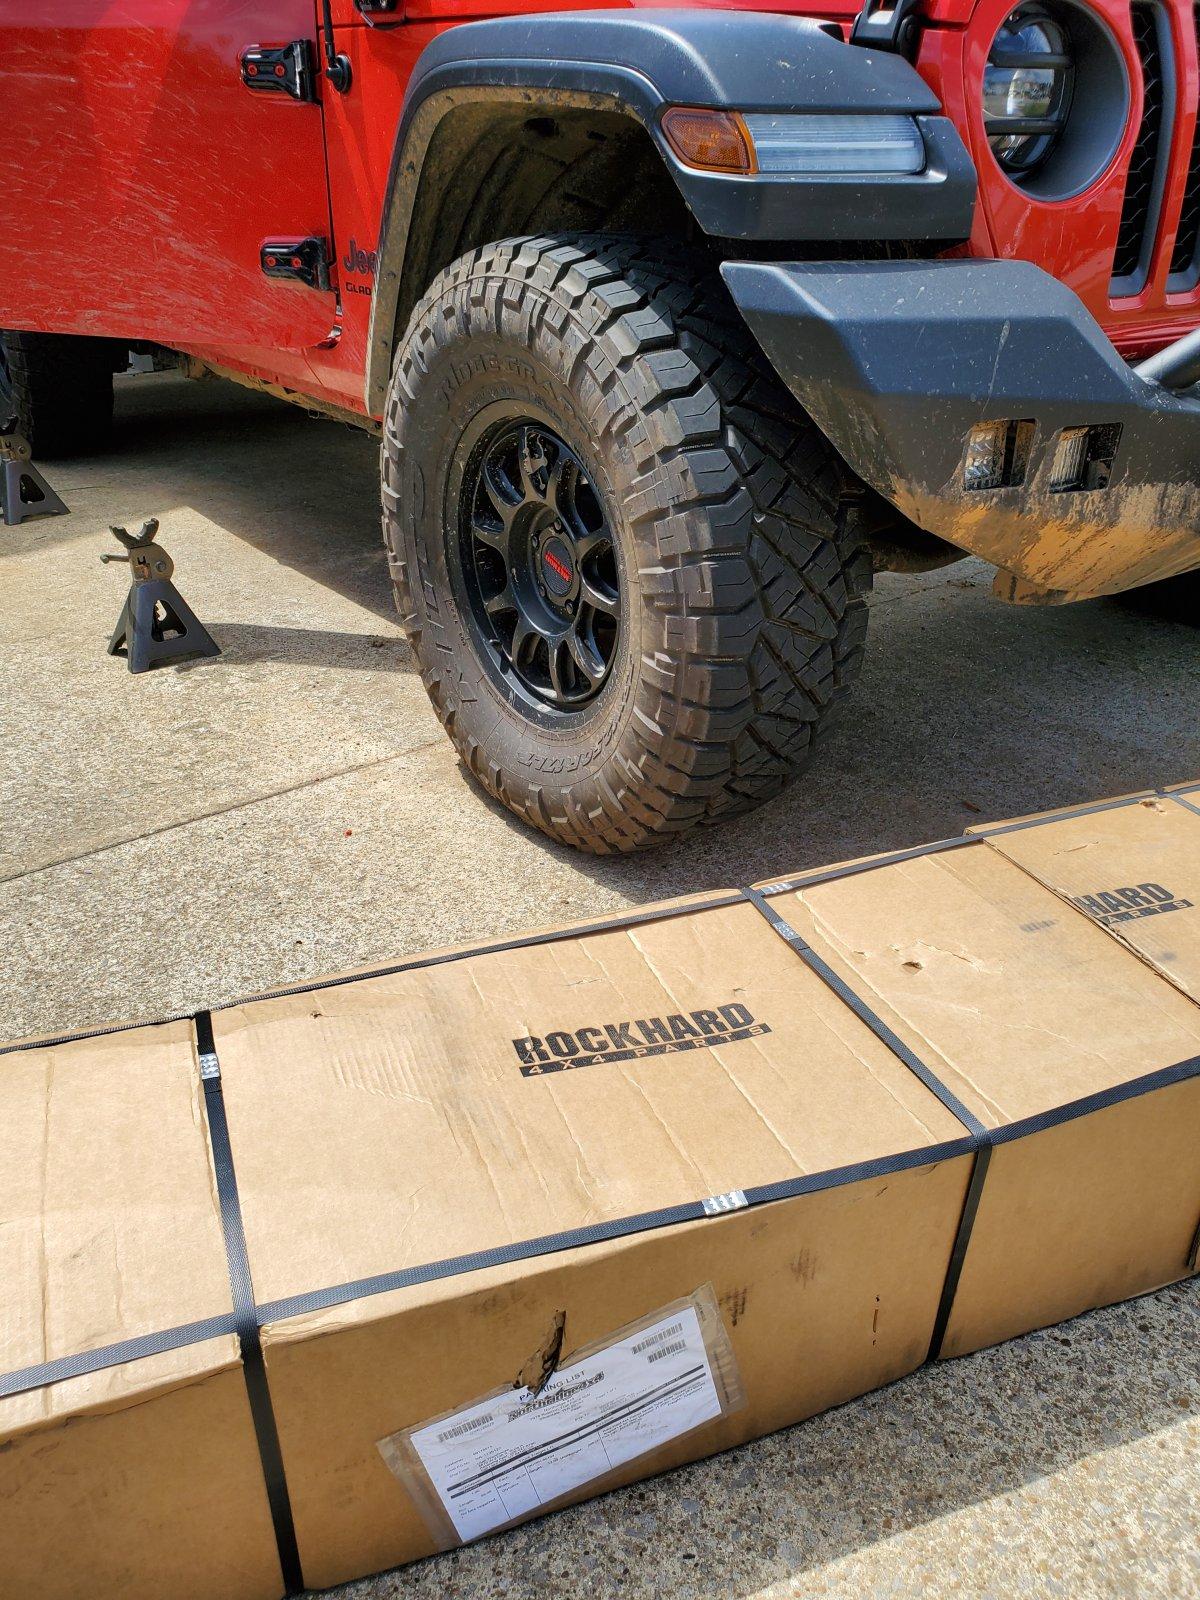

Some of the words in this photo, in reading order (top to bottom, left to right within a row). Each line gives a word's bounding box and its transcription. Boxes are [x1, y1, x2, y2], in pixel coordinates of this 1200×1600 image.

[512, 1002, 755, 1064] ROCKHARD
[635, 1024, 765, 1057] PARTS
[564, 1369, 586, 1383] LIST
